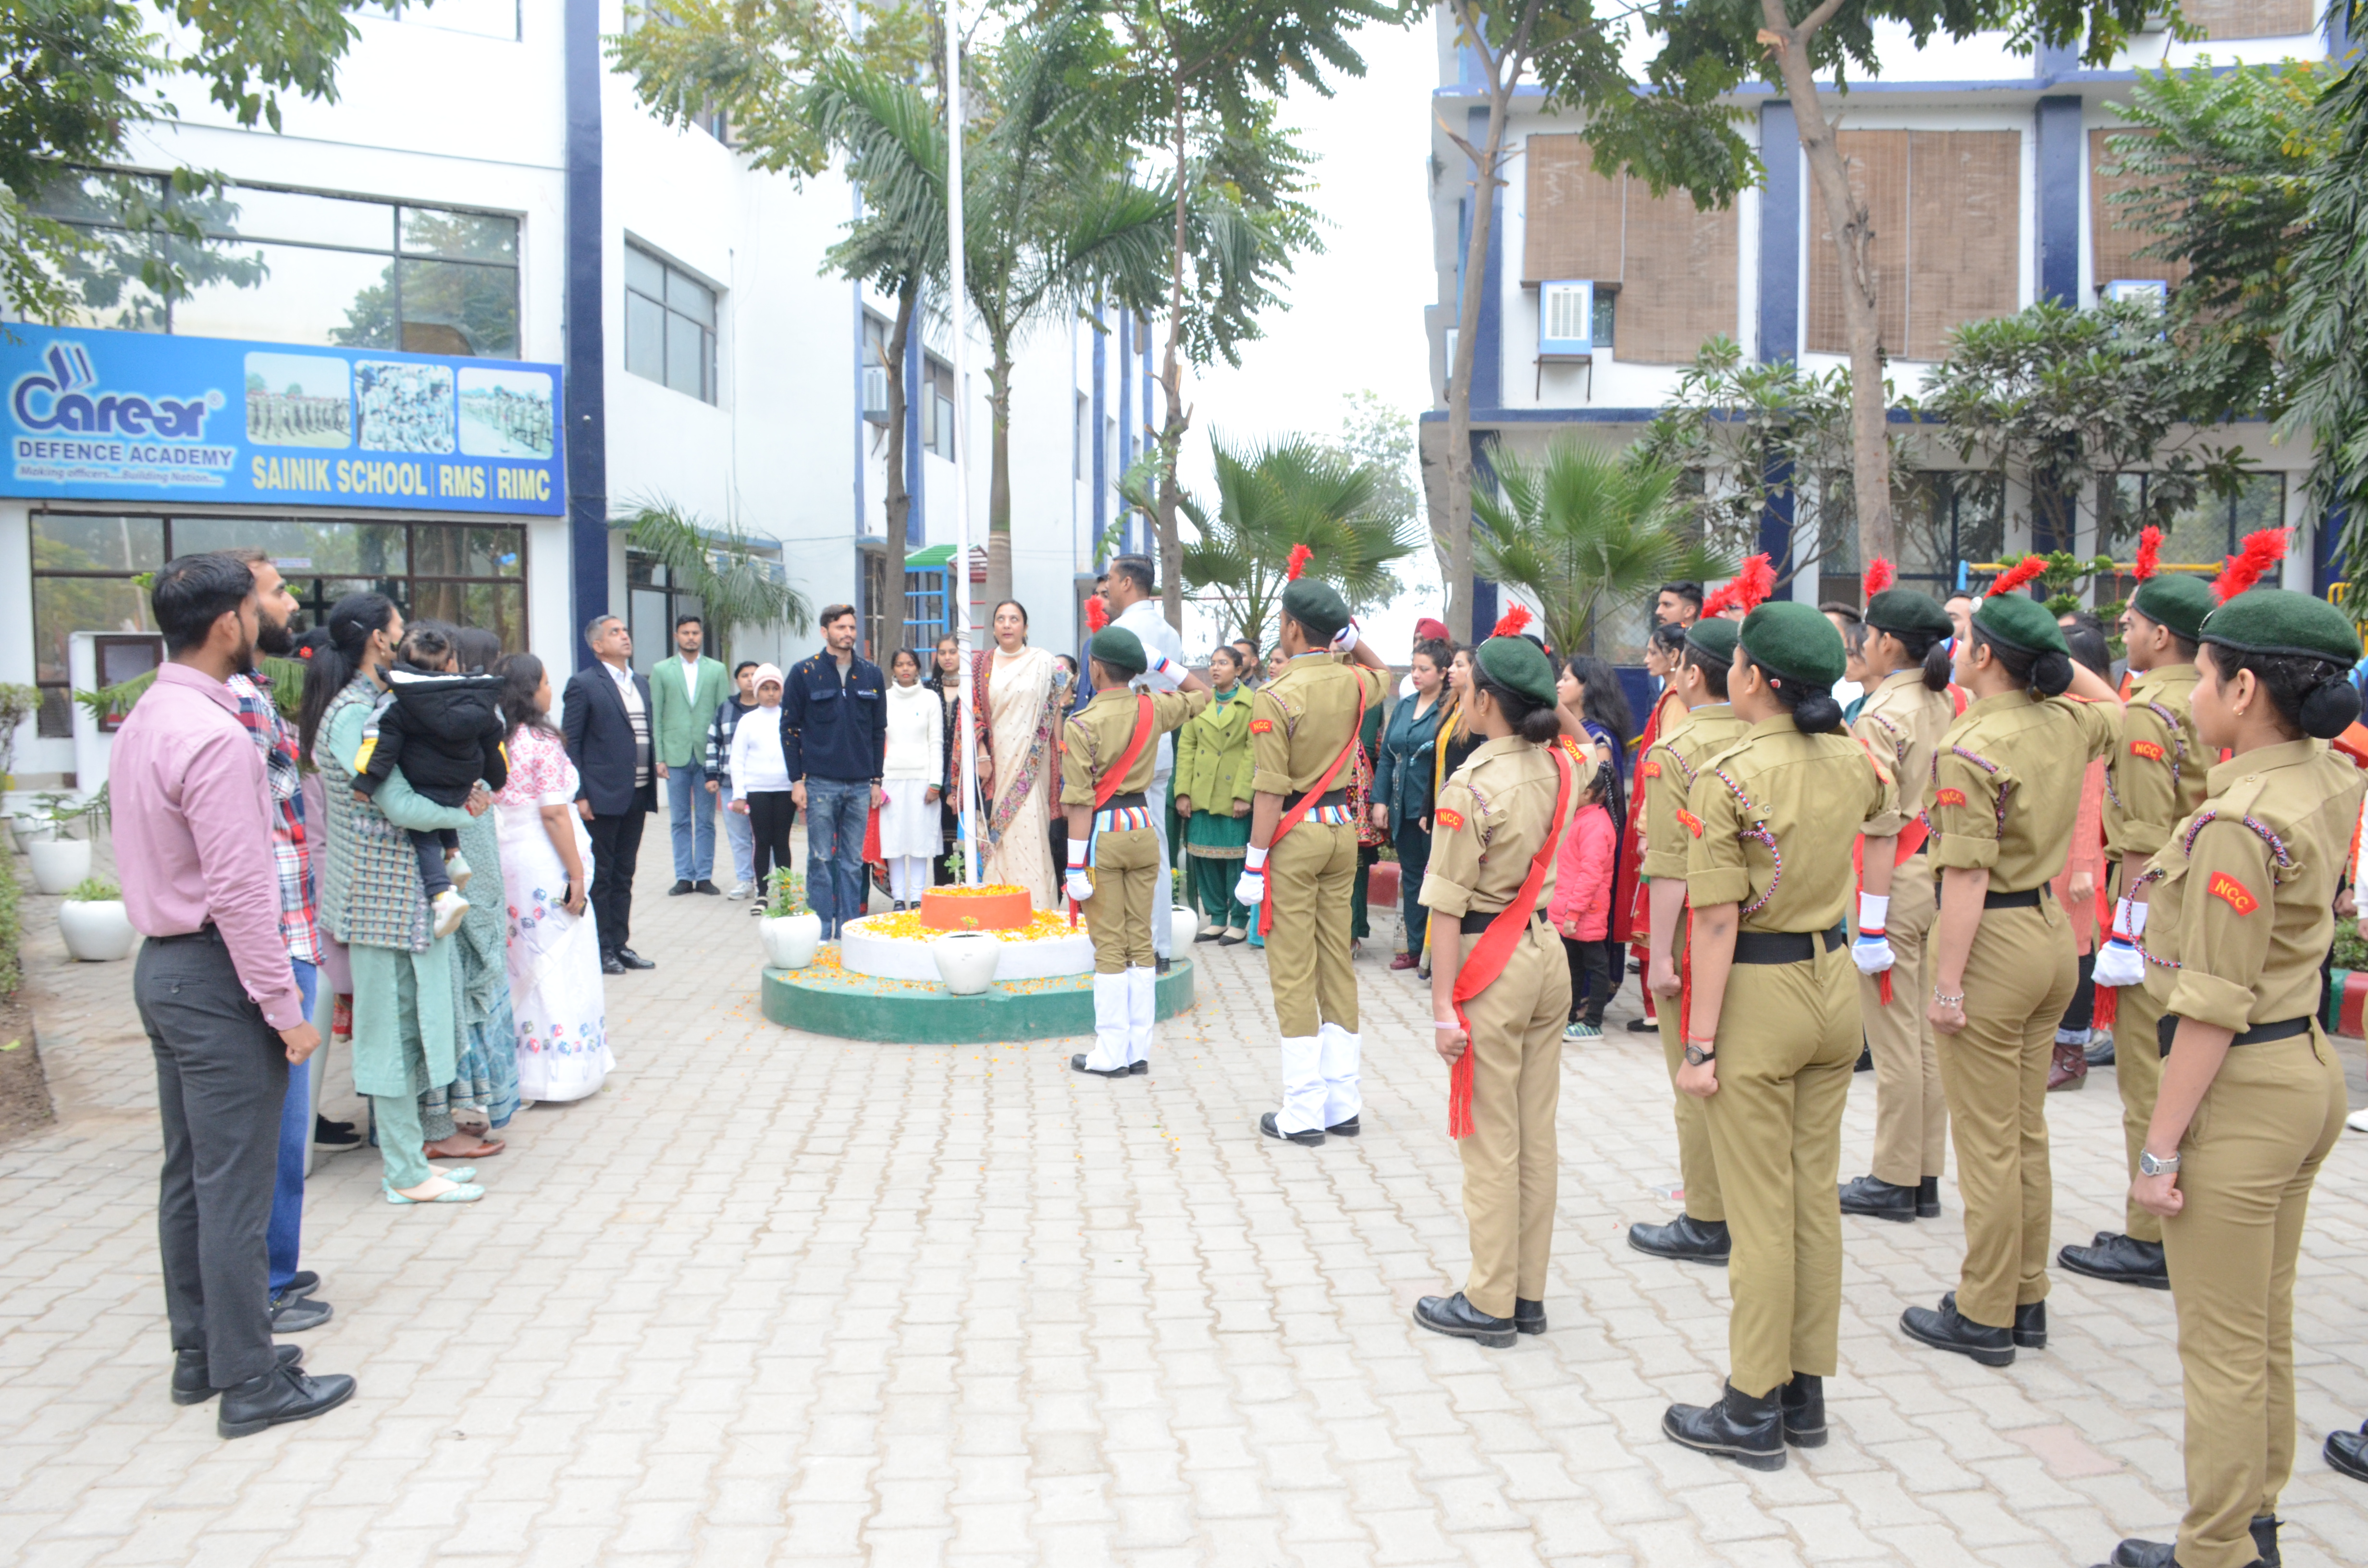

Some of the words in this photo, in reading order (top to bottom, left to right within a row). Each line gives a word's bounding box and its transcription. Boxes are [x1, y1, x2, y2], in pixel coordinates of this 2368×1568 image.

[19, 441, 122, 462] DEFENCE
[129, 446, 233, 466] ACADEMY
[251, 455, 332, 492] SAINIK
[336, 459, 428, 496] SCHOOL
[439, 465, 485, 499] RMS
[497, 467, 551, 502] RIMC
[1253, 722, 1269, 730] NCC
[1564, 739, 1582, 760] NCC
[2135, 743, 2159, 757] NCC
[1941, 791, 1962, 803] NCC
[1440, 811, 1459, 825] NCC
[1680, 810, 1697, 832] NCC
[2214, 879, 2249, 908] NCC
